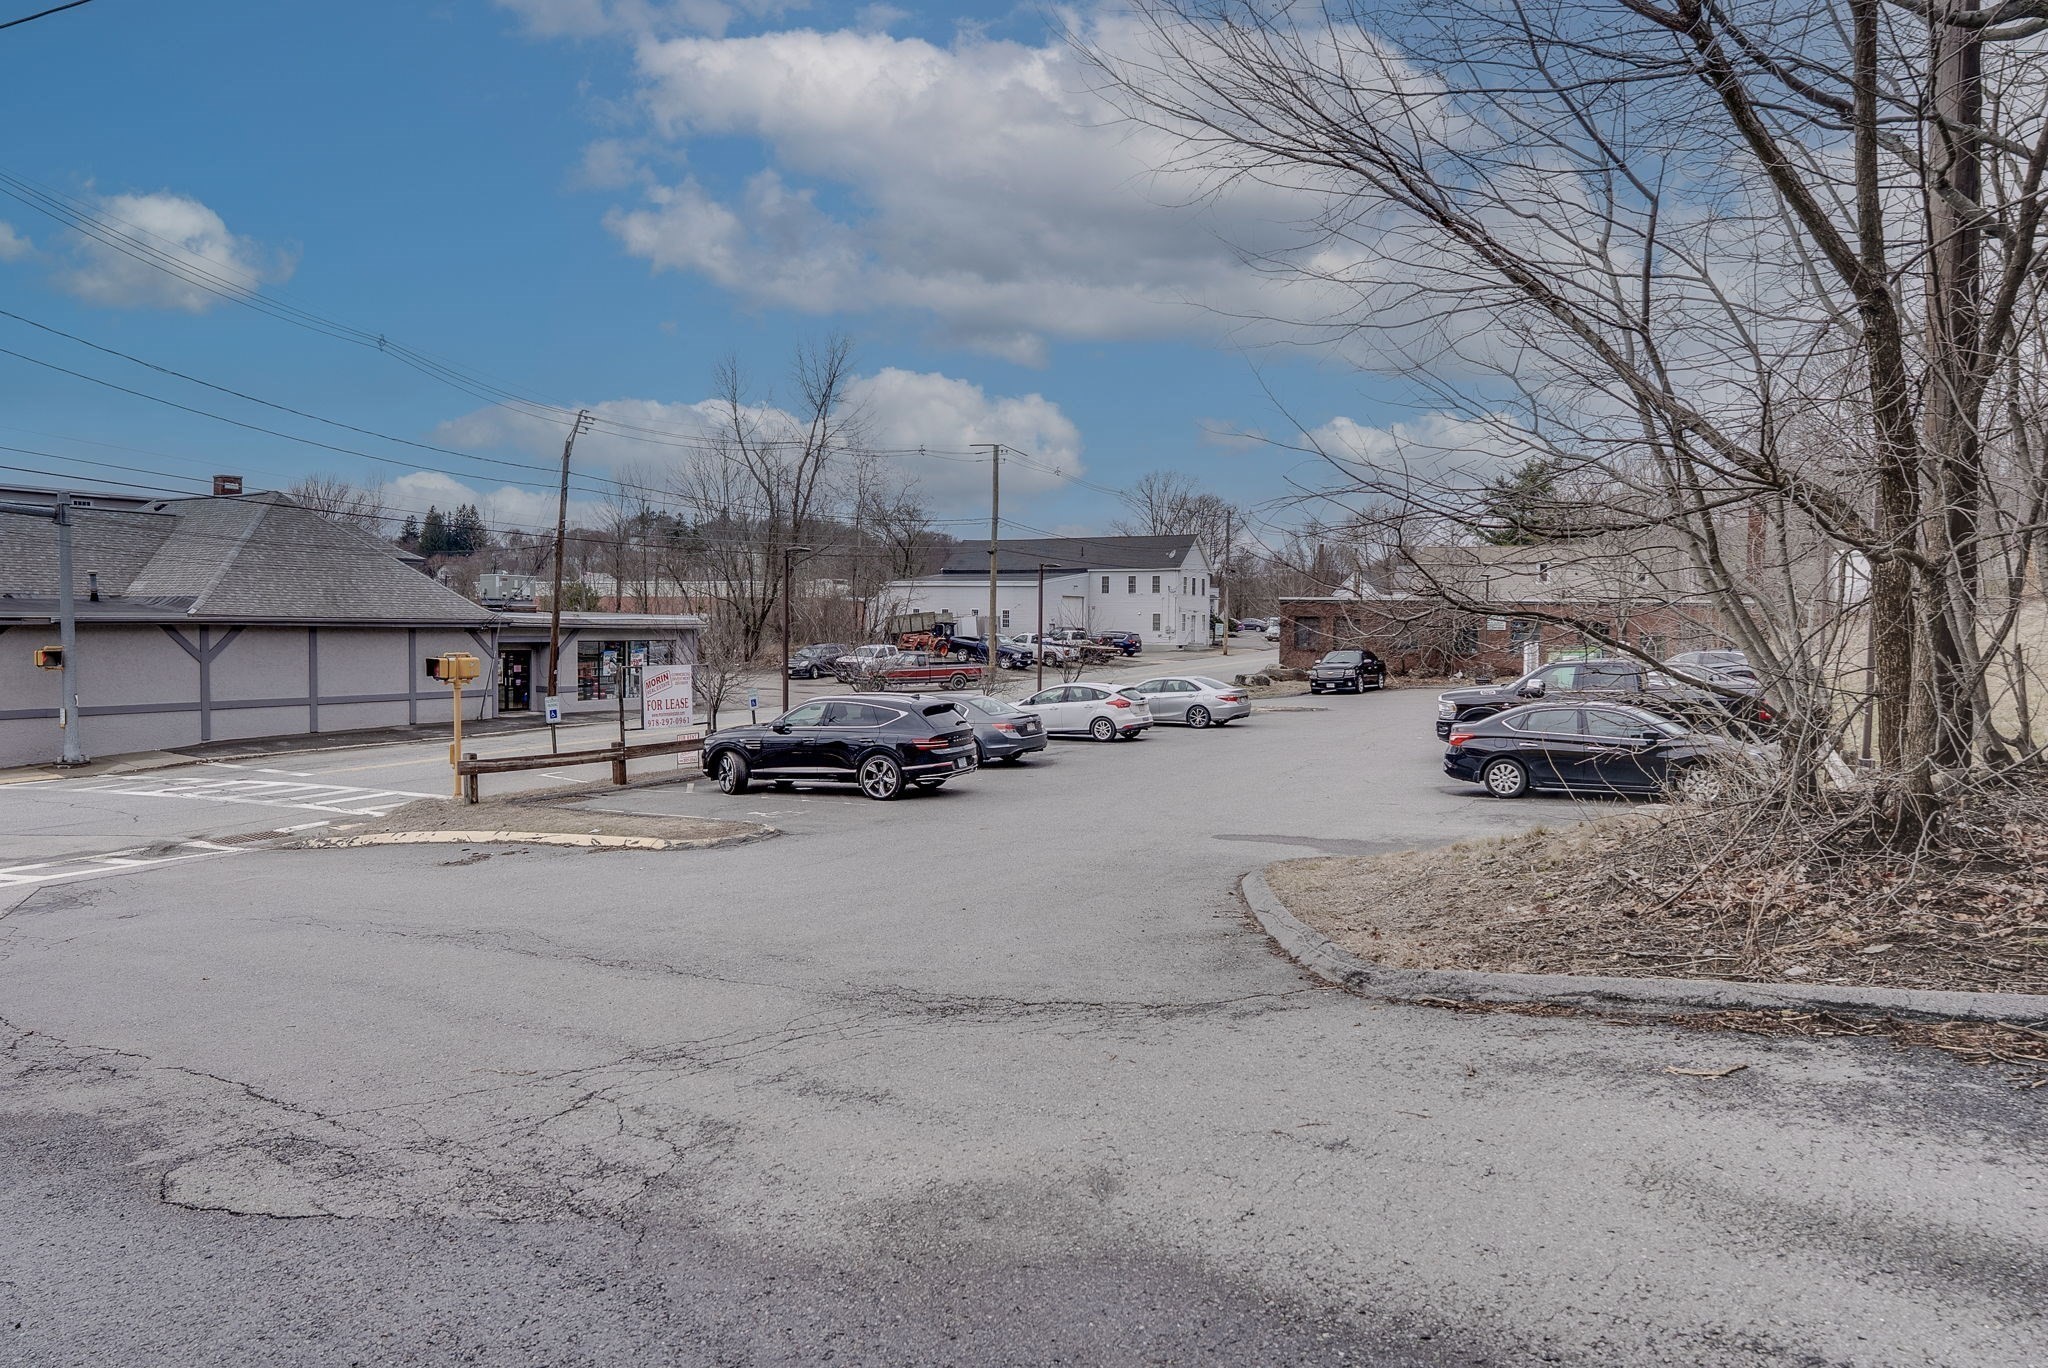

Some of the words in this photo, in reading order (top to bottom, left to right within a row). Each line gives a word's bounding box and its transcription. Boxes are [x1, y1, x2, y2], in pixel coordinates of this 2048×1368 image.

[645, 673, 669, 689] MORIN
[647, 699, 662, 711] FOR
[665, 698, 689, 710] LEASE
[647, 717, 690, 727] 978-297-0961
